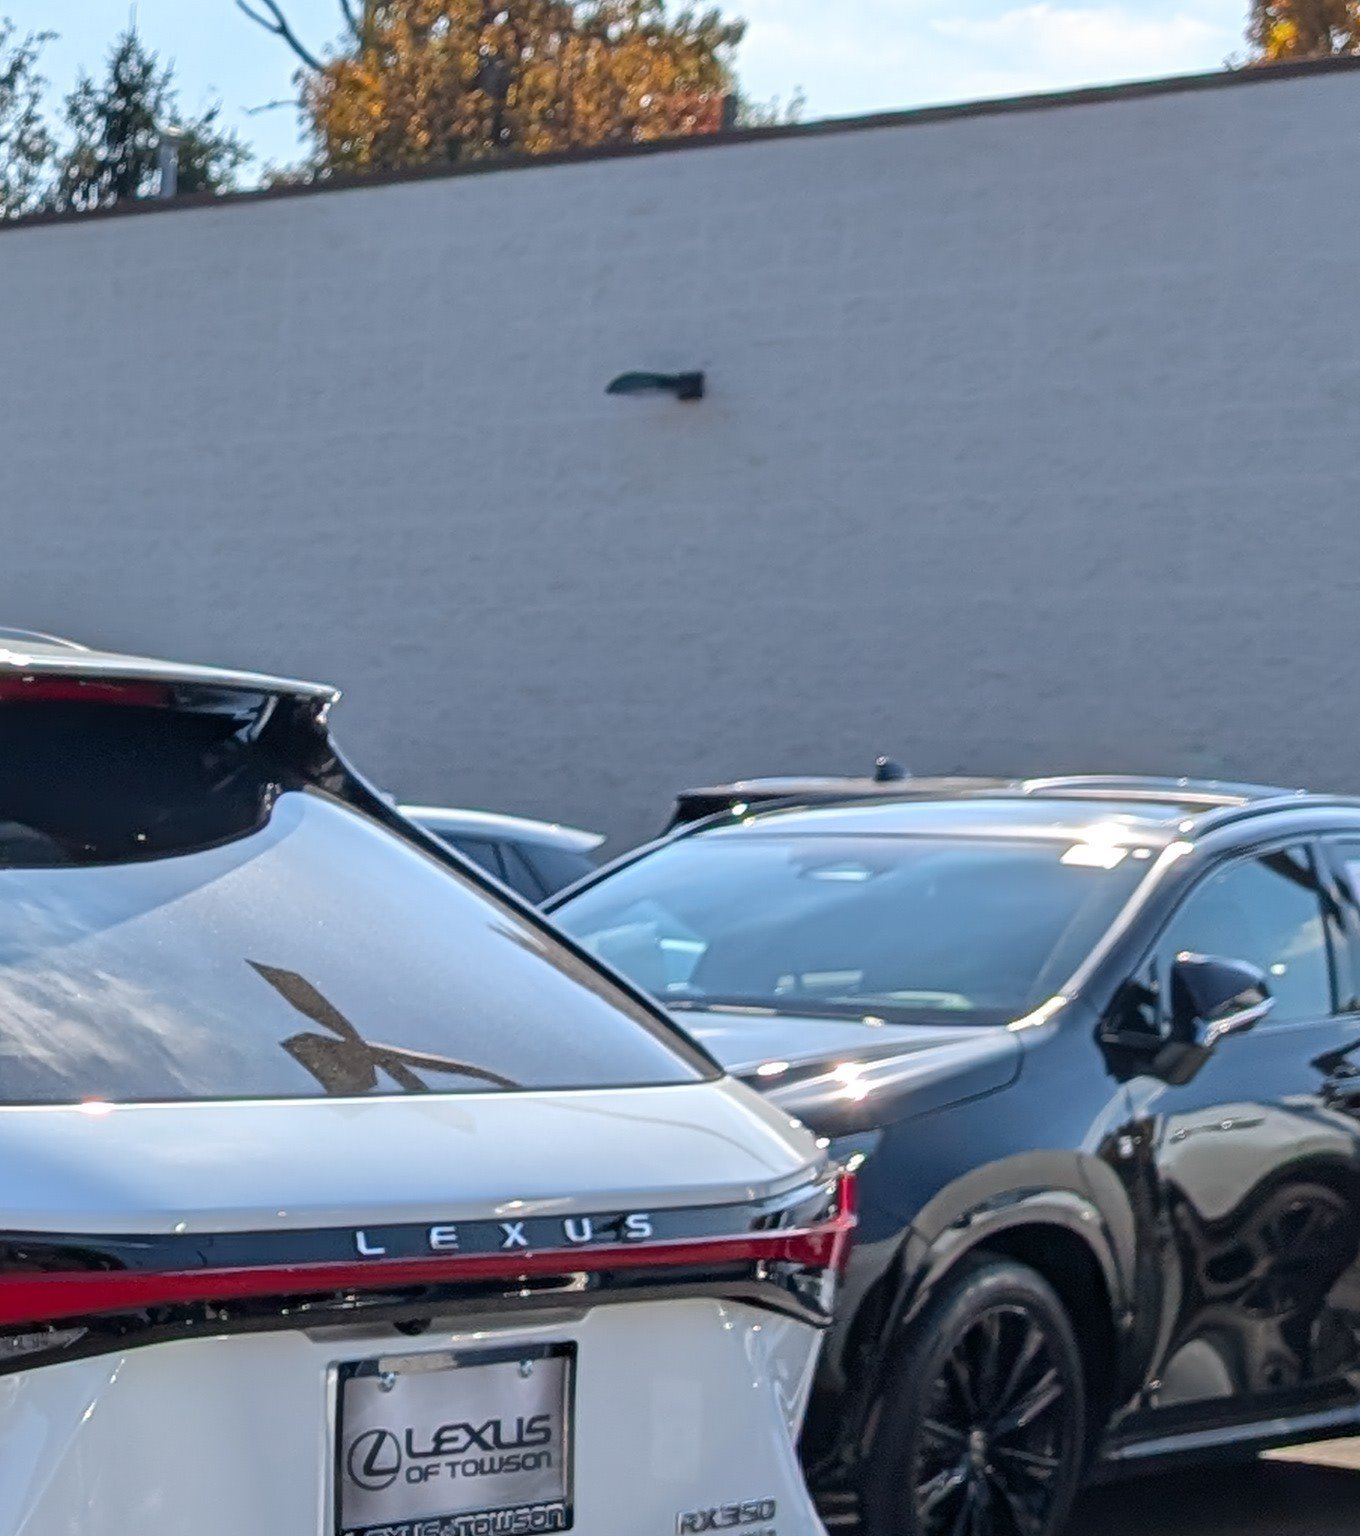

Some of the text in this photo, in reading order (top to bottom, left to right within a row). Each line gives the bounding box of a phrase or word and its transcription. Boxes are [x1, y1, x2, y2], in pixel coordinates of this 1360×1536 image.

[355, 1213, 653, 1256] LEXUS
[405, 1414, 552, 1459] LEXUS
[405, 1450, 553, 1485] OF TOWSON
[674, 1496, 777, 1536] RX350
